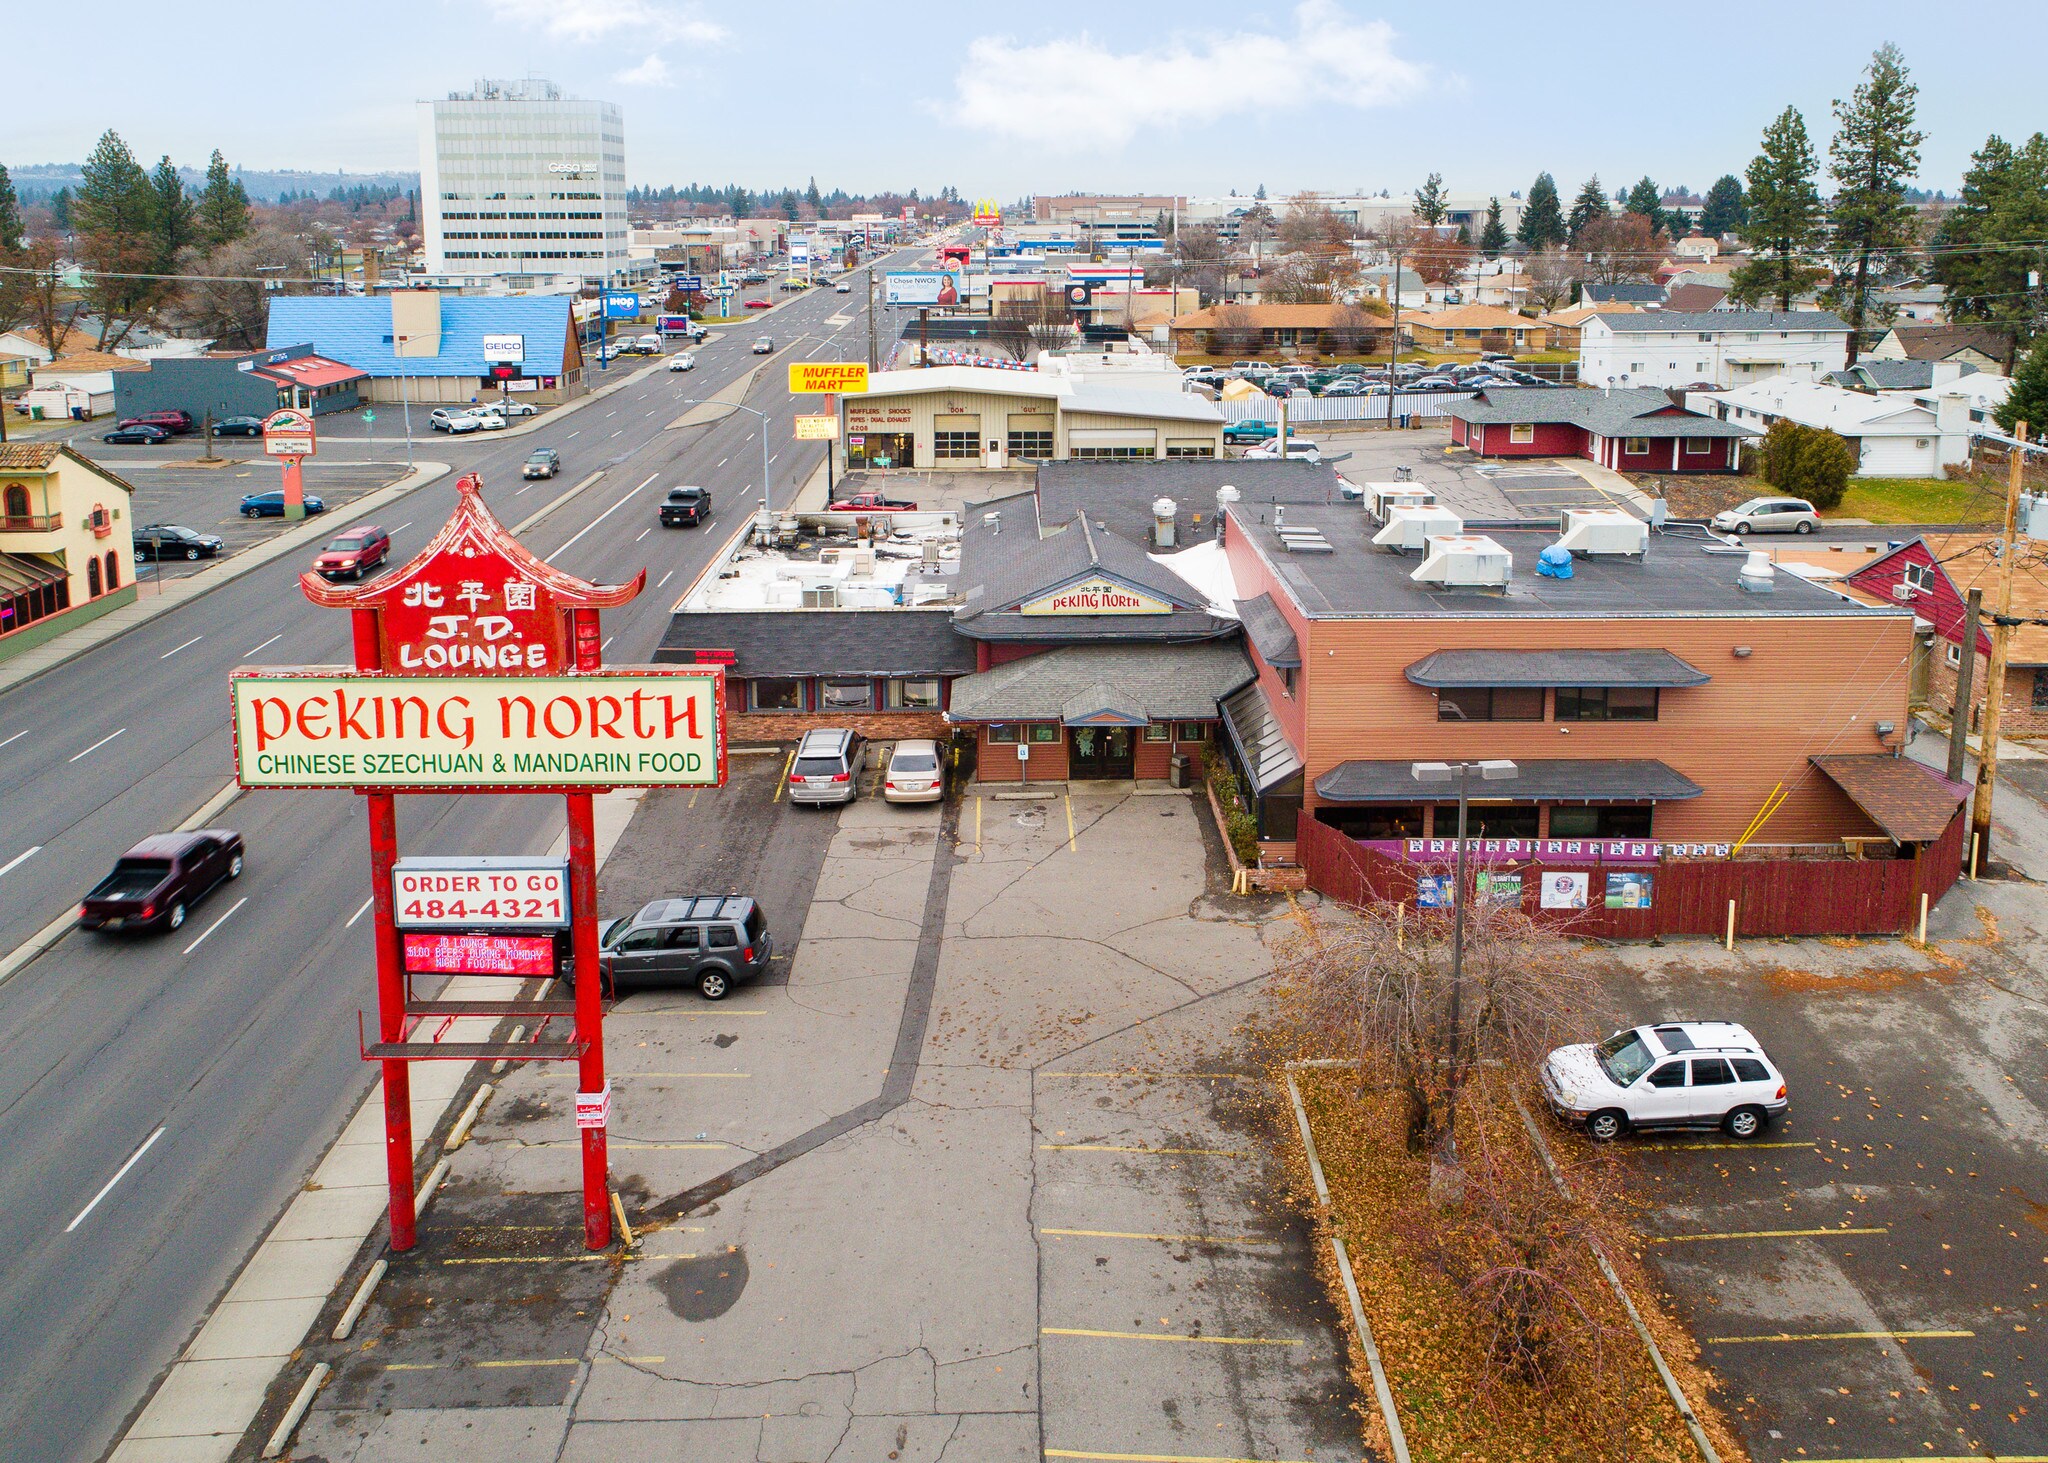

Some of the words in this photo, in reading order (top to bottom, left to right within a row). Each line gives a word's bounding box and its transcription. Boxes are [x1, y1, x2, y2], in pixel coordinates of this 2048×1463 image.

[549, 163, 580, 173] Gesa
[803, 367, 865, 378] MUFFLER
[805, 380, 860, 390] MART
[400, 643, 547, 669] LOUNGE
[258, 754, 356, 775] CHINESE
[363, 753, 483, 774] SZECHUAN
[492, 753, 507, 773] &
[514, 752, 631, 773] MANDARIN
[638, 752, 701, 773] FOOD
[402, 876, 481, 893] ORDER
[488, 876, 518, 892] TO
[527, 875, 559, 891] GO
[404, 898, 560, 919] 484-4321
[437, 937, 449, 948] JD
[454, 938, 489, 949] LOUNGE
[494, 938, 519, 950] ONLY
[434, 947, 464, 959] BEERS
[468, 949, 501, 959] DURING
[505, 950, 544, 961] MONDAY
[436, 957, 461, 968] NIGHT
[467, 958, 514, 970] FOOTBALL
